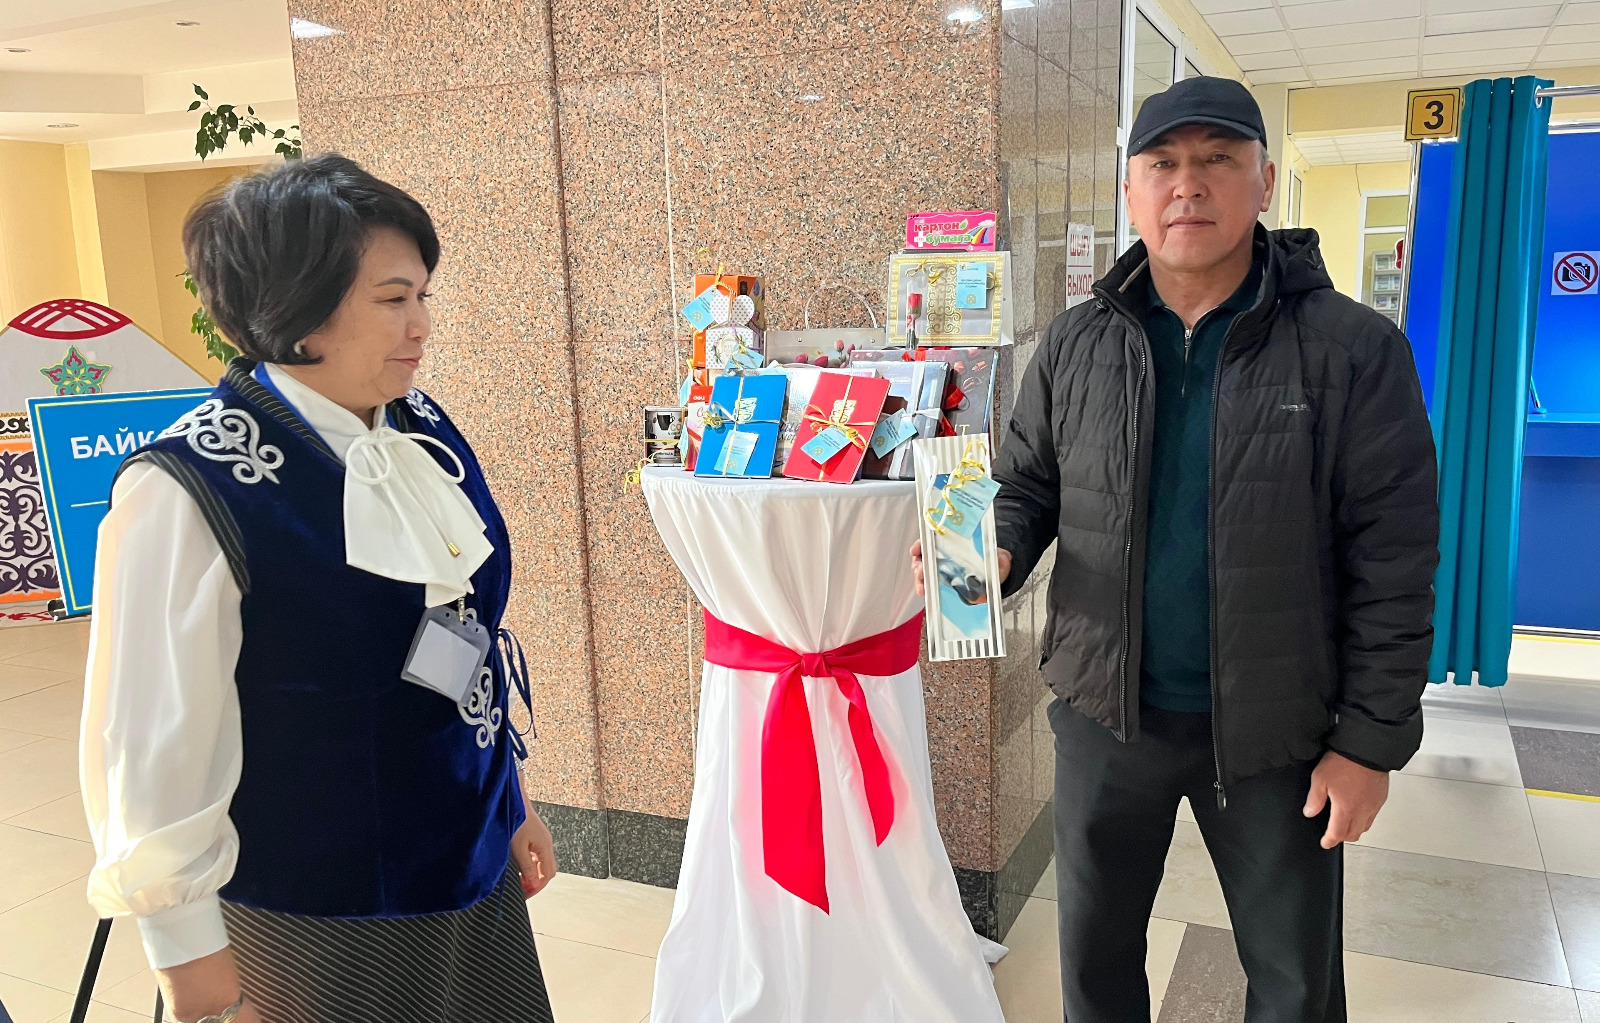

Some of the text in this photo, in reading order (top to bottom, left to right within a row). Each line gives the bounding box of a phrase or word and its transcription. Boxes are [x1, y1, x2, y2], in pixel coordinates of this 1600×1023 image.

[1424, 100, 1444, 130] 3
[914, 222, 960, 233] картон
[925, 234, 972, 246] бумага
[1068, 274, 1093, 298] ВЫХОД
